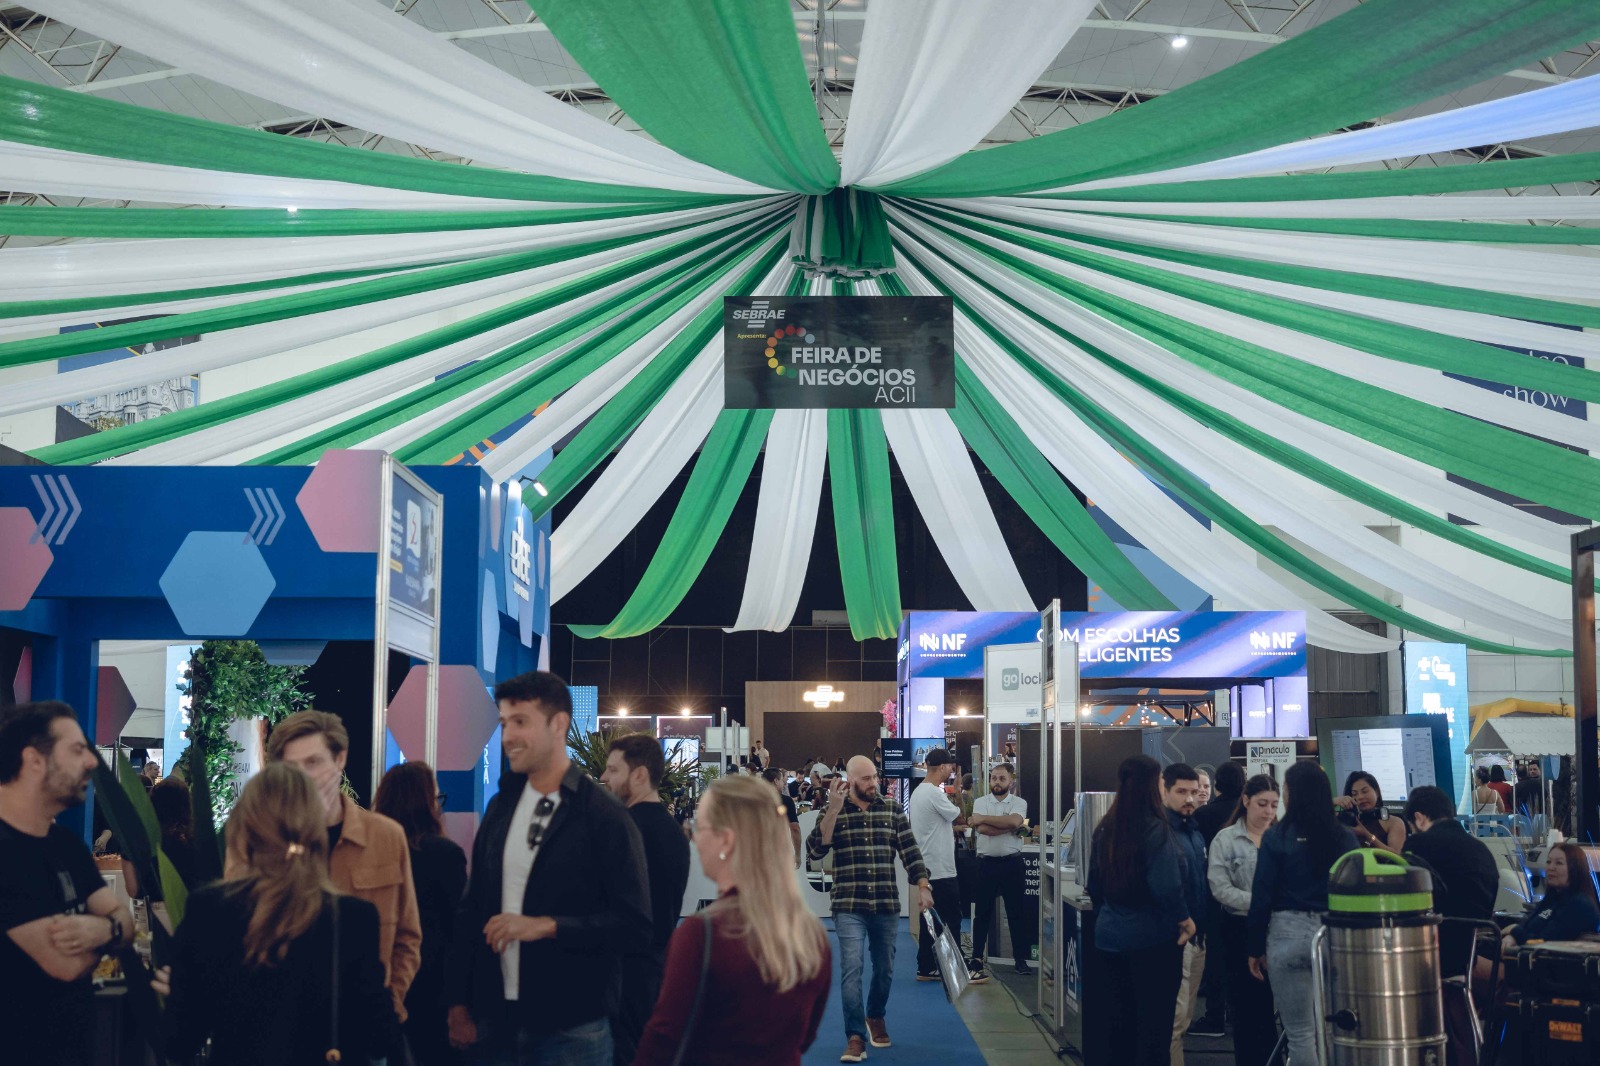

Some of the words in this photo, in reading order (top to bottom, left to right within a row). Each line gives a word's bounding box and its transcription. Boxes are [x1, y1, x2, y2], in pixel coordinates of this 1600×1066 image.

[732, 309, 786, 319] SEBRAE
[791, 347, 852, 363] FEIRA
[855, 347, 882, 363] DE
[798, 364, 916, 386] NEGÓCIOS
[874, 386, 916, 403] ACII
[942, 633, 967, 650] NF
[1084, 627, 1181, 643] ESCOLHAS
[1272, 631, 1297, 649] NF
[1078, 647, 1173, 662] ELIGENTES
[1003, 674, 1018, 687] go
